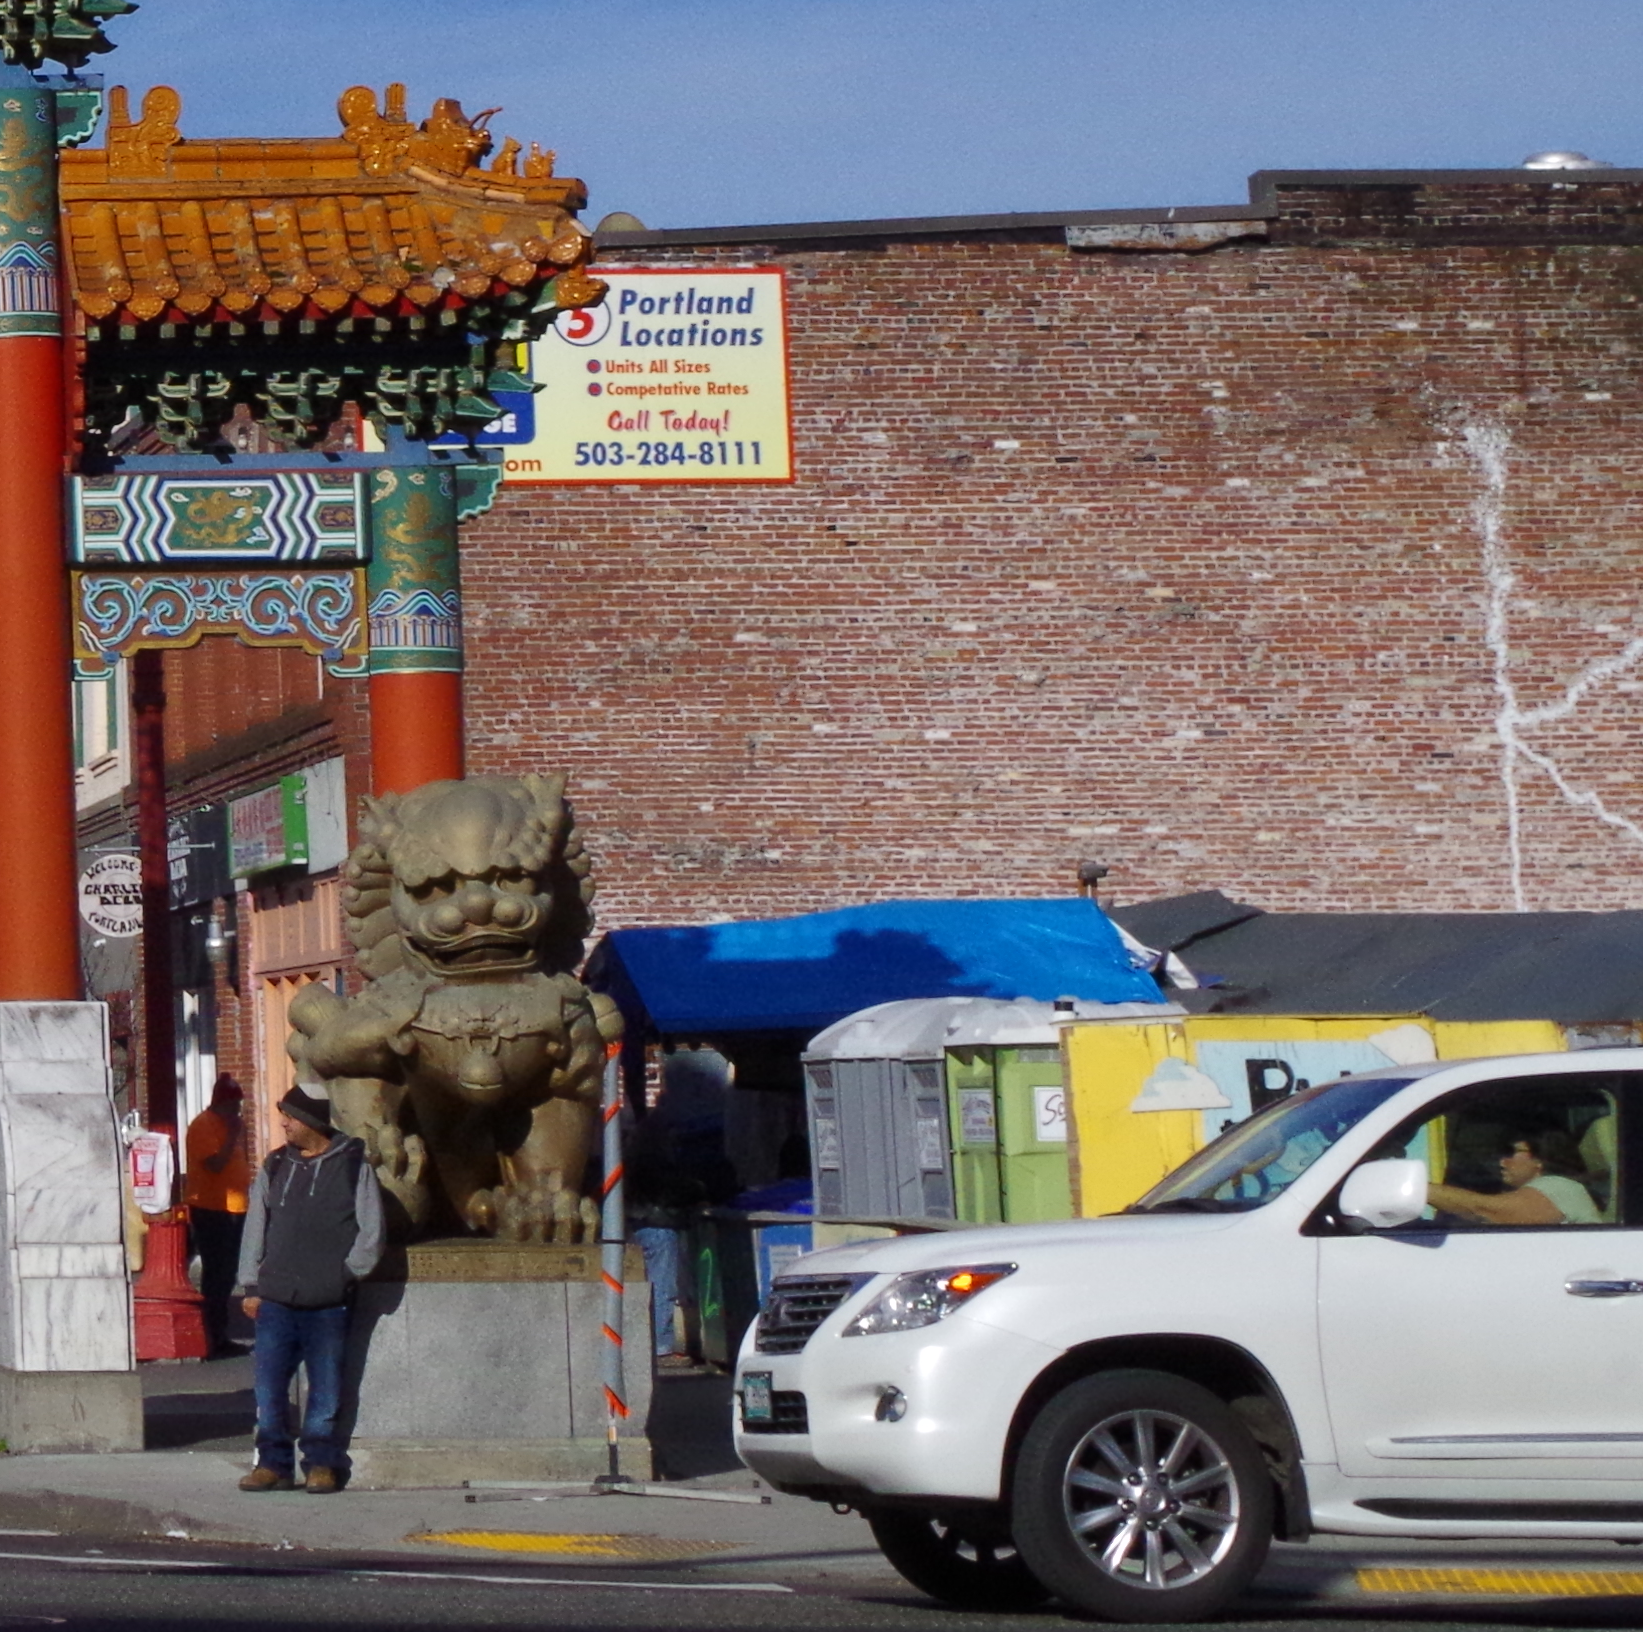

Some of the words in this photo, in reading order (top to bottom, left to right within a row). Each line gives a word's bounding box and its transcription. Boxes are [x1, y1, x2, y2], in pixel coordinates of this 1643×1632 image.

[619, 286, 755, 316] Portland
[565, 305, 596, 339] 5
[619, 319, 764, 348] Locations
[605, 360, 644, 374] Units
[649, 360, 668, 374] All
[673, 360, 711, 374] Sizes
[606, 382, 701, 398] Competative
[706, 382, 749, 396] Rates
[607, 410, 650, 432] Call
[660, 410, 731, 436] Today!
[574, 441, 762, 466] 503-284-8111
[84, 883, 143, 895] CHARLI
